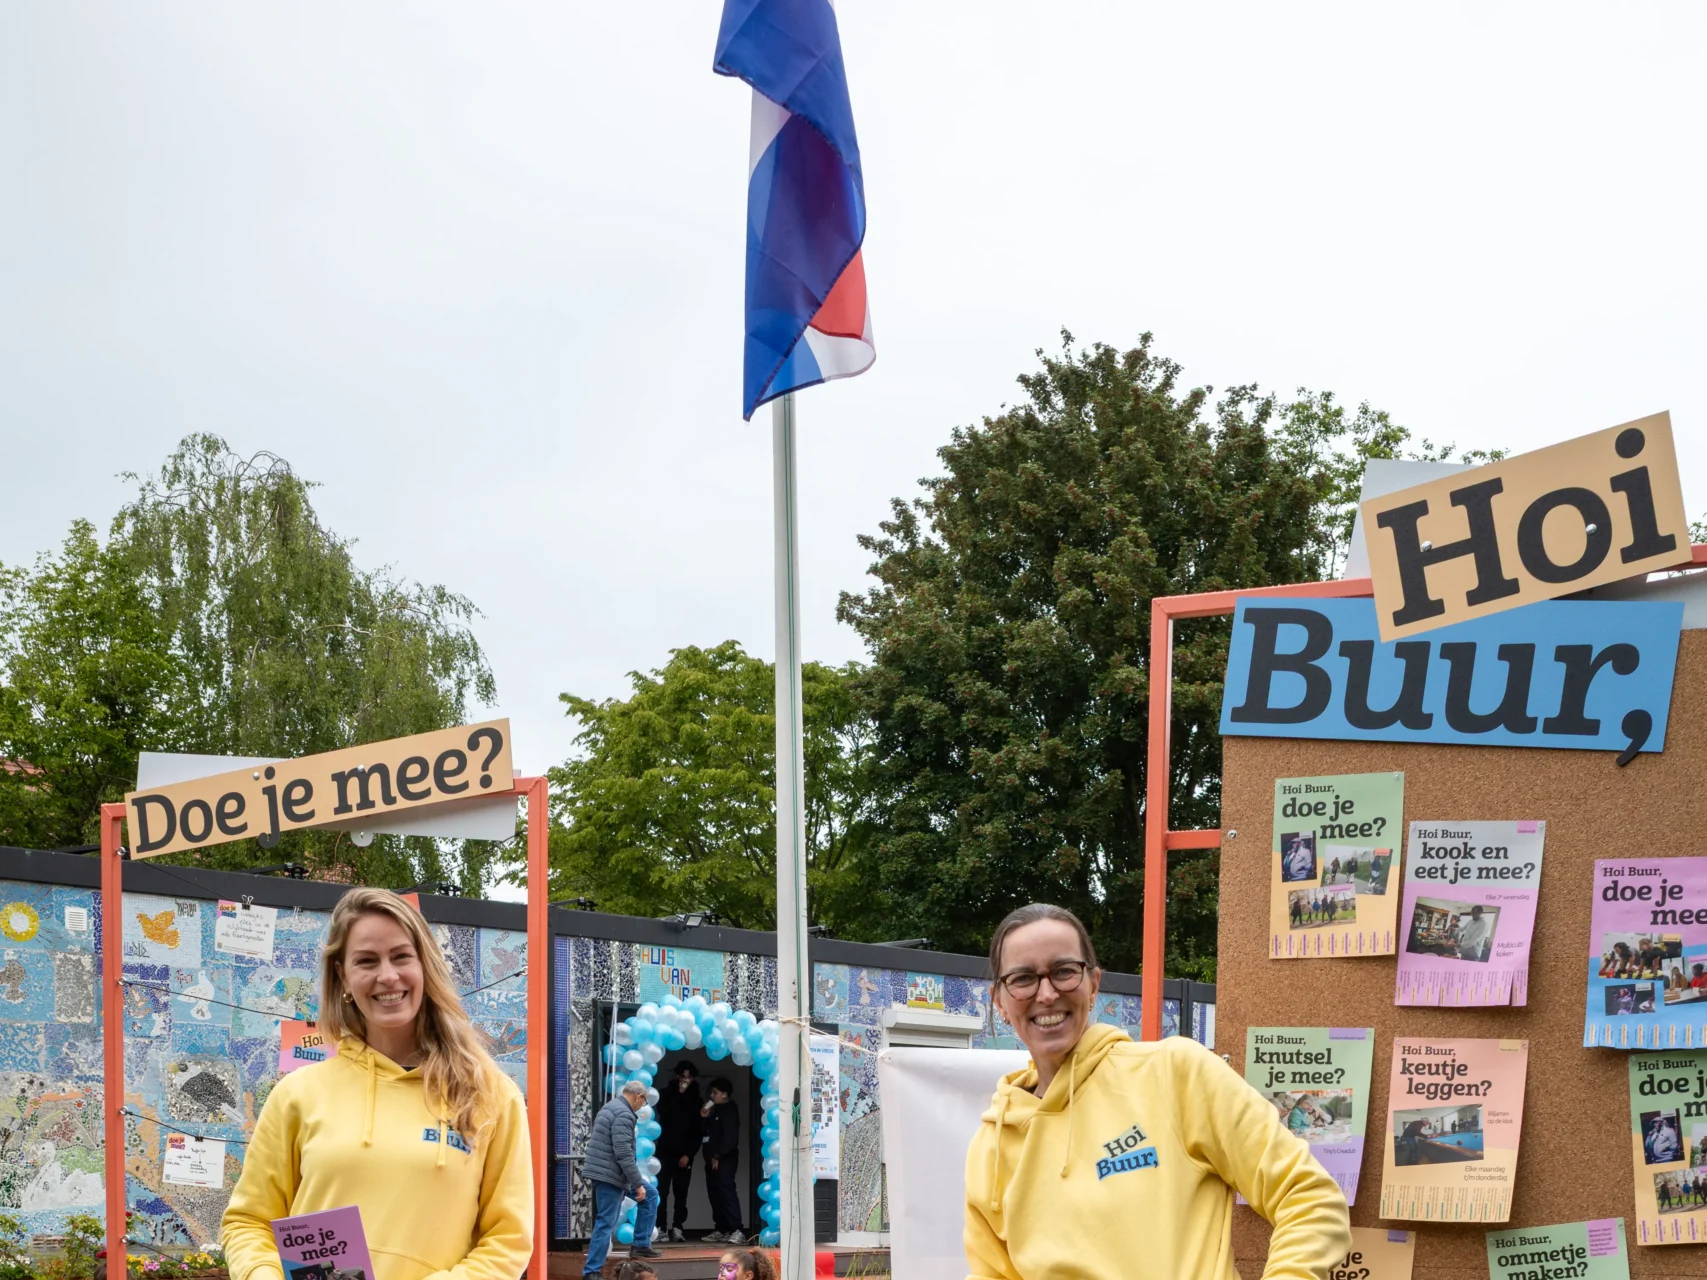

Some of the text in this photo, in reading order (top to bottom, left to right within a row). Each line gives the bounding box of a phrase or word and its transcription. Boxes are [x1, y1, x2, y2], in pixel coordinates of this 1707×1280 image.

[1376, 427, 1677, 627] Hoi
[1230, 607, 1653, 767] Buur,
[131, 727, 503, 853] Doe je mee?
[1282, 784, 1335, 794] Hoi Buur,
[1282, 794, 1355, 822] doe je
[1320, 817, 1387, 839] mee?
[1417, 829, 1473, 840] Hoi Buur,
[1420, 842, 1509, 860] kook en
[1414, 861, 1536, 884] eet je mee?
[1603, 866, 1662, 877] Hoi Buur,
[1602, 878, 1684, 907] doe je
[1650, 909, 1707, 926] mee
[641, 947, 675, 967] HUIS
[661, 967, 690, 986] VAN
[302, 1033, 324, 1048] Hoi
[1254, 1035, 1307, 1046] Hoi Buur,
[1253, 1047, 1333, 1065] knutsel
[1401, 1045, 1456, 1057] Hoi Buur,
[1400, 1058, 1468, 1081] keutje
[1637, 1059, 1697, 1072] Hoi Buur,
[1265, 1066, 1346, 1088] je mee?
[1638, 1073, 1690, 1096] doe
[1406, 1077, 1493, 1101] leggen?
[1103, 1125, 1147, 1159] Hoi
[1096, 1152, 1158, 1180] Buur,
[1478, 1166, 1506, 1174] maandag
[1476, 1174, 1508, 1182] donderdag
[282, 1228, 336, 1248] doe je
[1495, 1235, 1552, 1249] Hoi Buur,
[301, 1241, 348, 1261] mee?
[1497, 1243, 1587, 1267] ommetje
